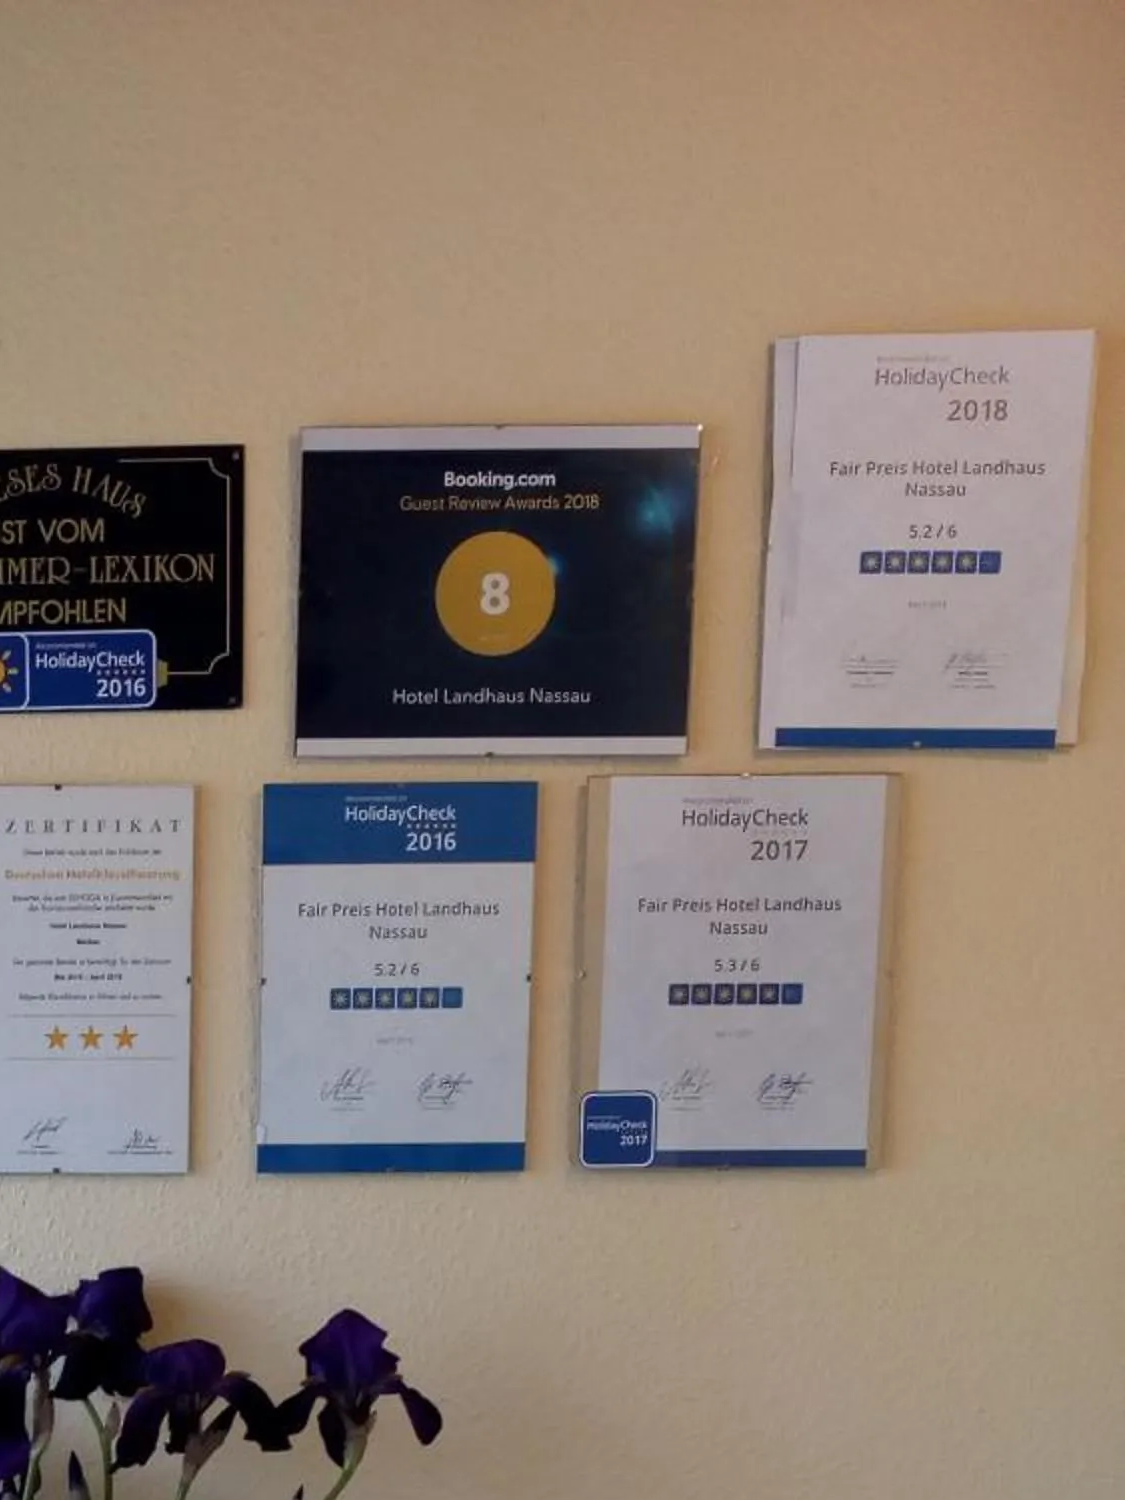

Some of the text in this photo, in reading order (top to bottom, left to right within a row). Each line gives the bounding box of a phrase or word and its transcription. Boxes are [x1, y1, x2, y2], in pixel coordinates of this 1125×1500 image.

[875, 366, 1010, 390] HolidayCheck
[947, 399, 1008, 421] 2018
[830, 460, 1046, 477] Fair Preis Hotel Landhaus
[443, 470, 556, 490] Booking.com
[72, 464, 147, 519] HAUS
[905, 482, 966, 497] Nassau
[400, 494, 600, 511] Guest Review Awards 2018
[37, 518, 106, 543] VOM
[909, 525, 932, 539] 5.2
[947, 525, 957, 539] 6
[479, 572, 510, 615] 8
[35, 650, 145, 673] HolidayCheck
[96, 678, 146, 697] 2016
[392, 687, 591, 705] Hotel Landhaus Nassau
[345, 804, 457, 826] HolidayCheck
[682, 807, 809, 832] HolidayCheck
[5, 819, 182, 834] ZERTIFIKAT
[406, 832, 457, 851] 2016
[750, 840, 809, 861] 2017
[298, 902, 500, 917] Fair Preis Hotel Landhaus
[638, 896, 842, 913] Fair Preis Hotel Landhaus
[369, 925, 428, 940] Nassau
[709, 921, 768, 935] Nassau
[375, 963, 397, 977] 5.2
[410, 963, 420, 977] 6
[714, 958, 736, 973] 5.3
[750, 958, 760, 972] 6
[620, 1135, 648, 1146] 2017
